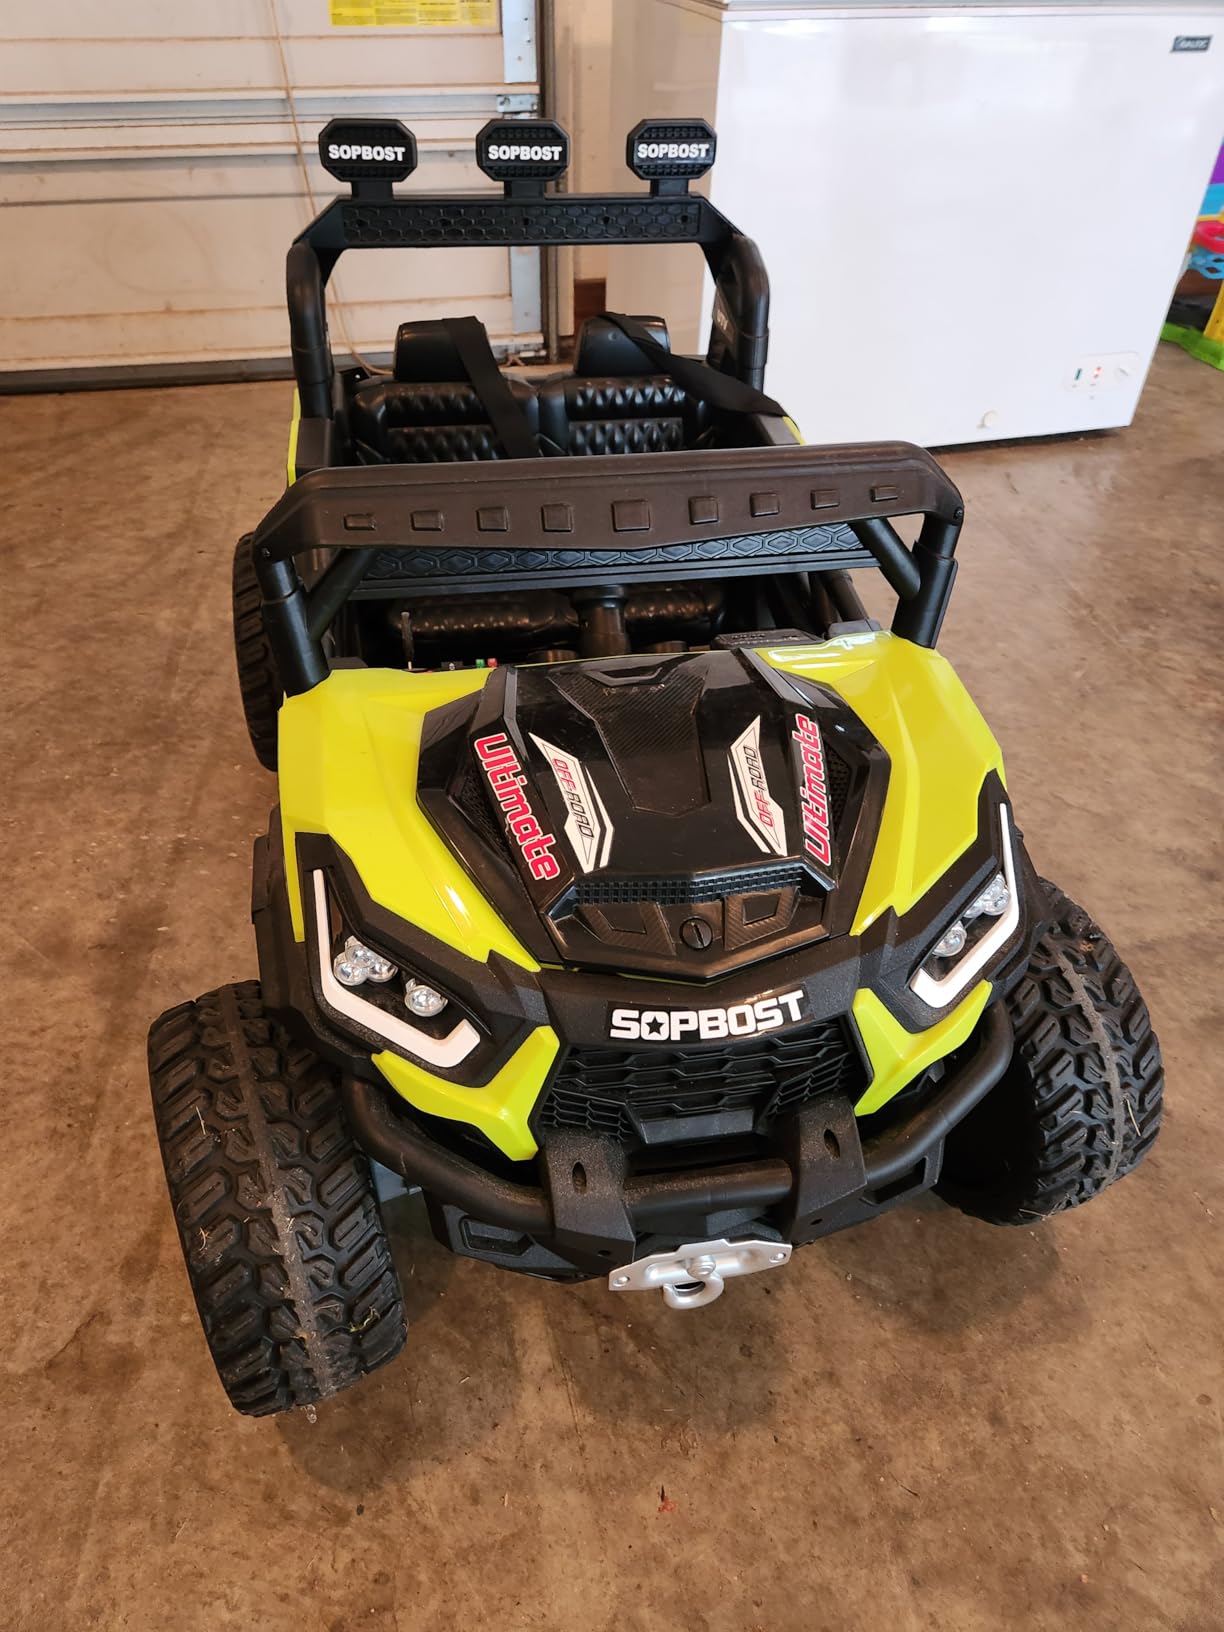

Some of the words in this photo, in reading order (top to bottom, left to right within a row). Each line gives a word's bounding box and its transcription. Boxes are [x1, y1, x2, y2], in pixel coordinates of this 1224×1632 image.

[327, 144, 406, 163] SOPBOST
[487, 144, 563, 162] SOPBOST
[636, 142, 711, 160] SOPBOST
[474, 732, 561, 881] Ultimate
[791, 712, 832, 867] Ultimate
[609, 990, 806, 1042] SOPBOST
